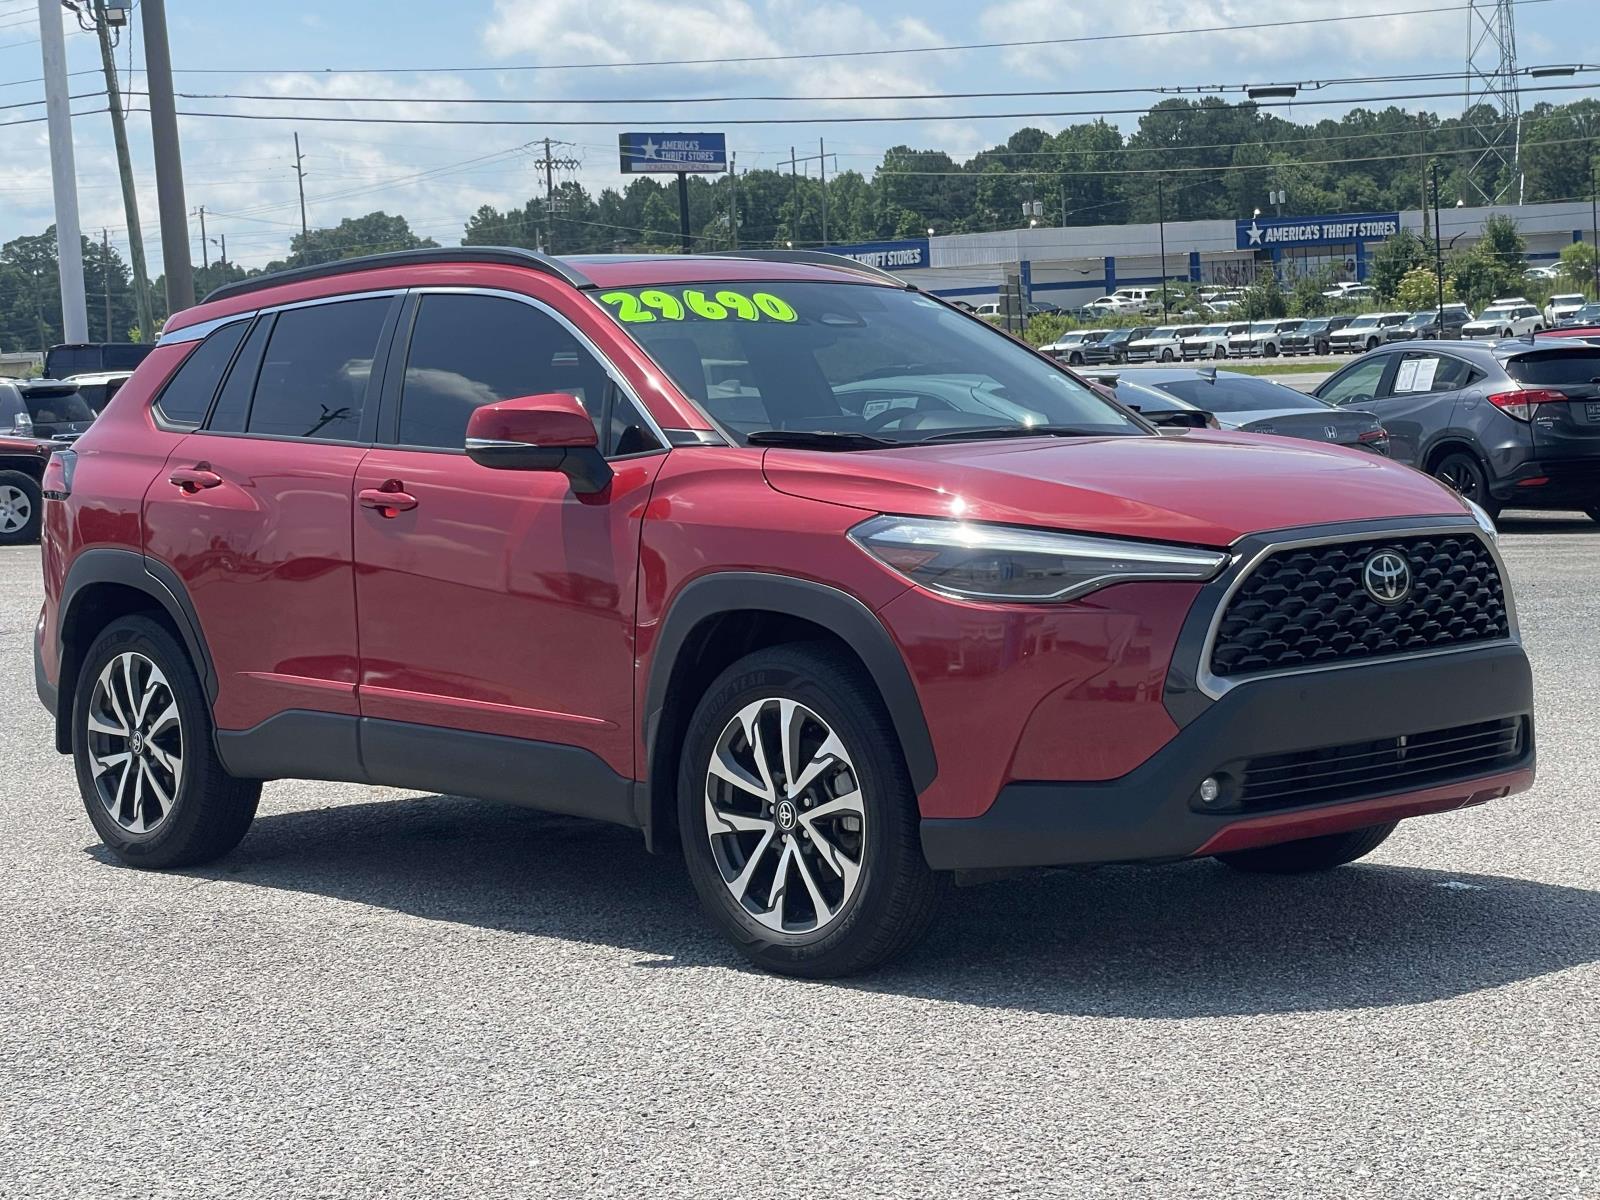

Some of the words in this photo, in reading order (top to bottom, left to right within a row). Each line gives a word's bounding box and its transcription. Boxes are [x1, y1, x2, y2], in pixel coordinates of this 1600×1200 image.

[661, 141, 699, 150] AMERICA'S
[661, 151, 687, 161] THRIFT
[688, 151, 714, 161] STORES
[1265, 225, 1320, 243] AMERICA'S
[1322, 223, 1358, 239] THRIFT
[1359, 221, 1396, 236] STORES
[887, 249, 921, 266] STORES
[600, 290, 798, 322] 29690
